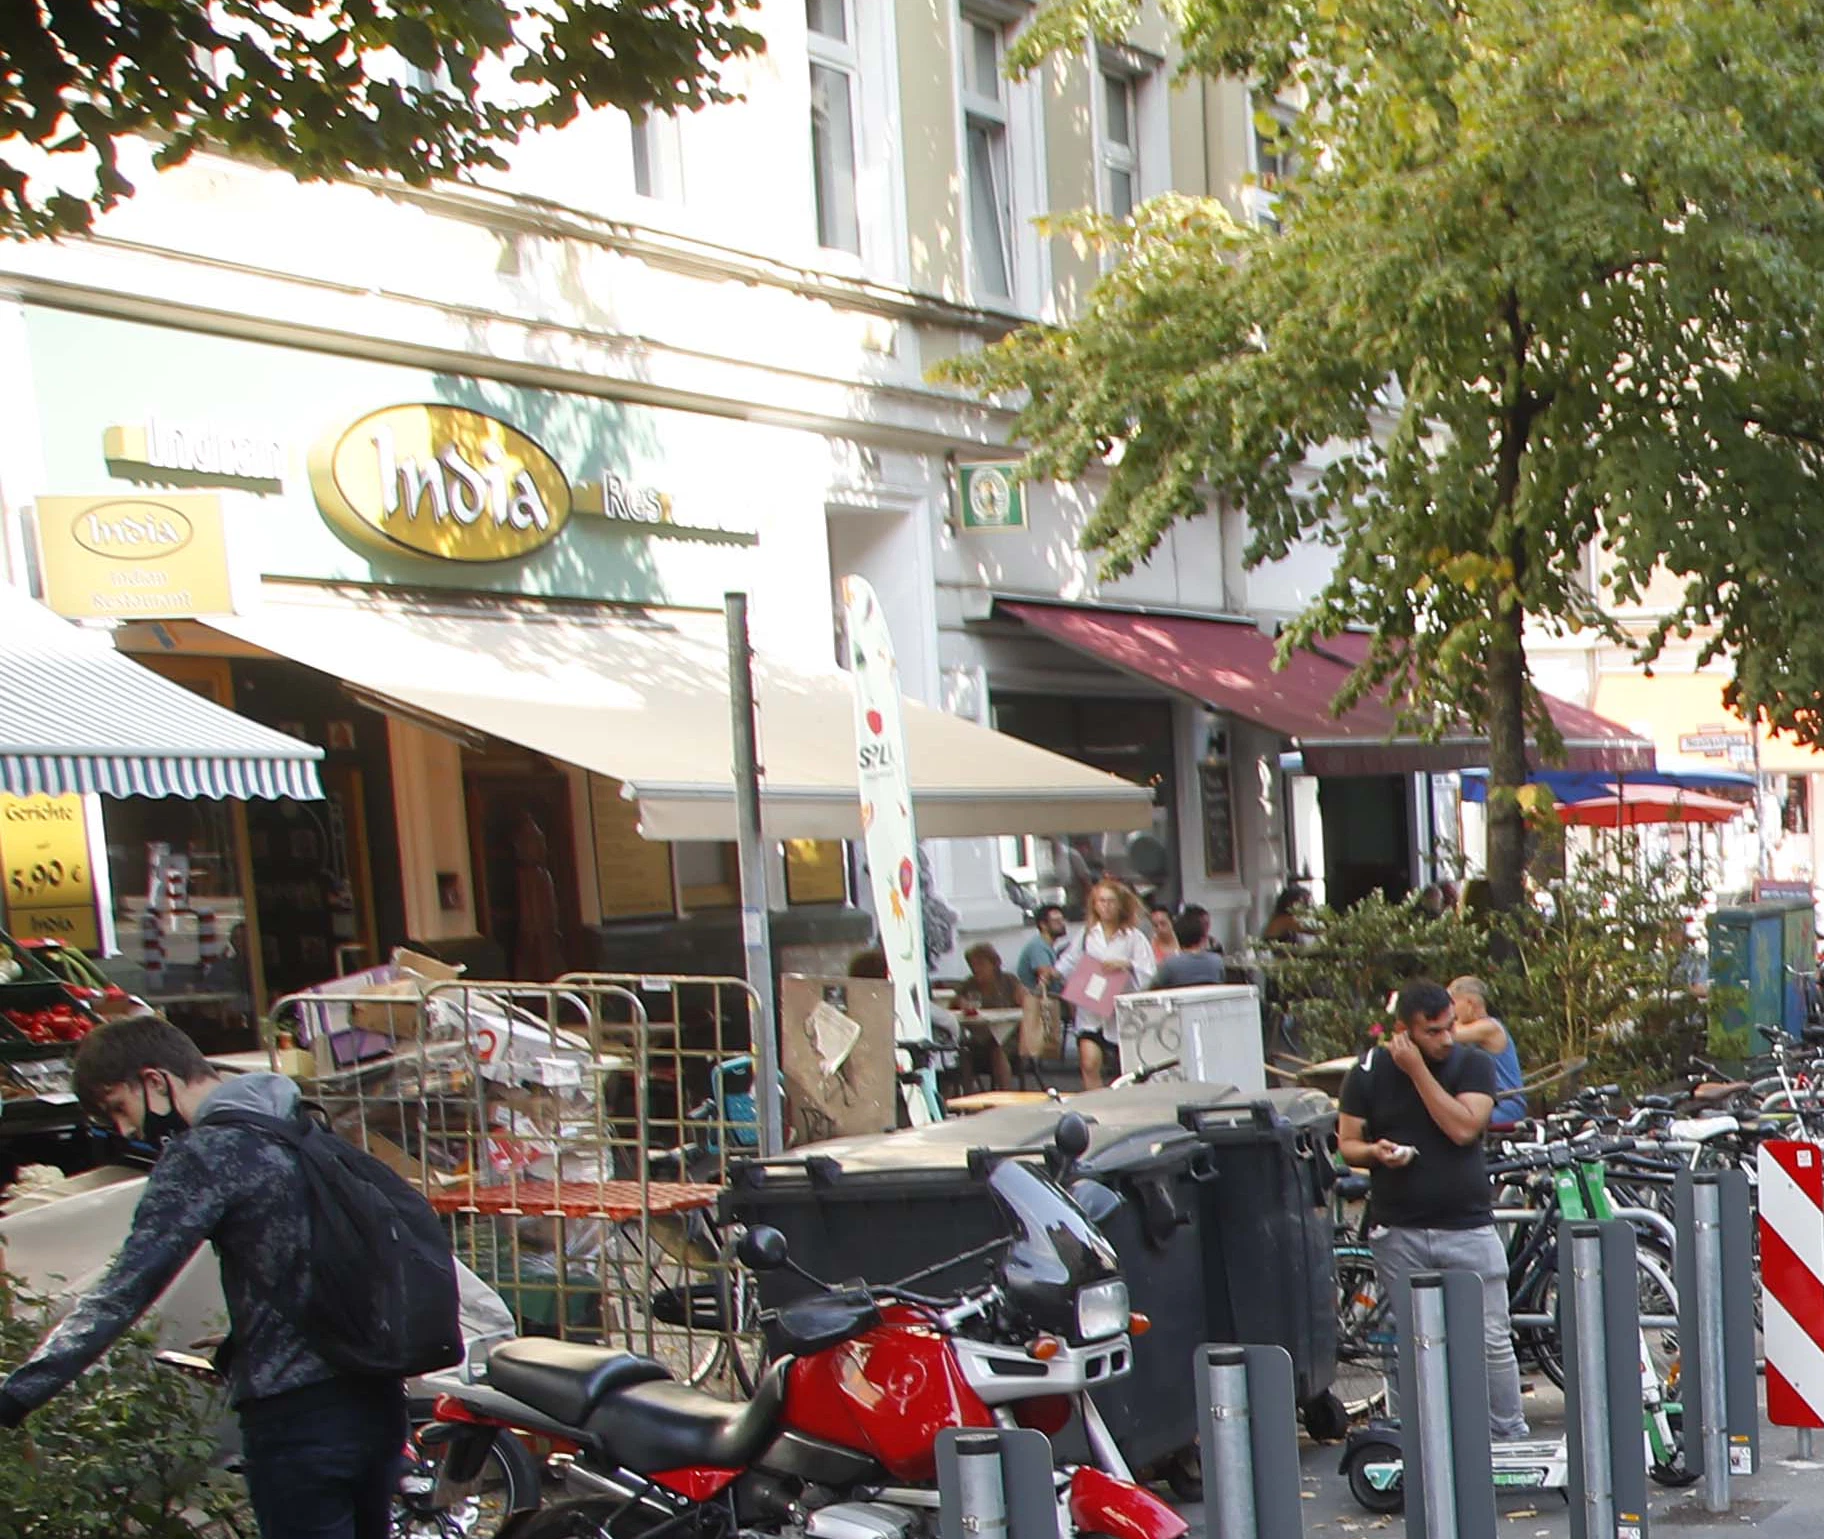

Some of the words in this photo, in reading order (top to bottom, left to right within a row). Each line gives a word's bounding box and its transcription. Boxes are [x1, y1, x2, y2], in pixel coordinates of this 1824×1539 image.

[370, 425, 549, 532] India
[86, 513, 181, 545] India
[12, 858, 65, 896] 5,90
